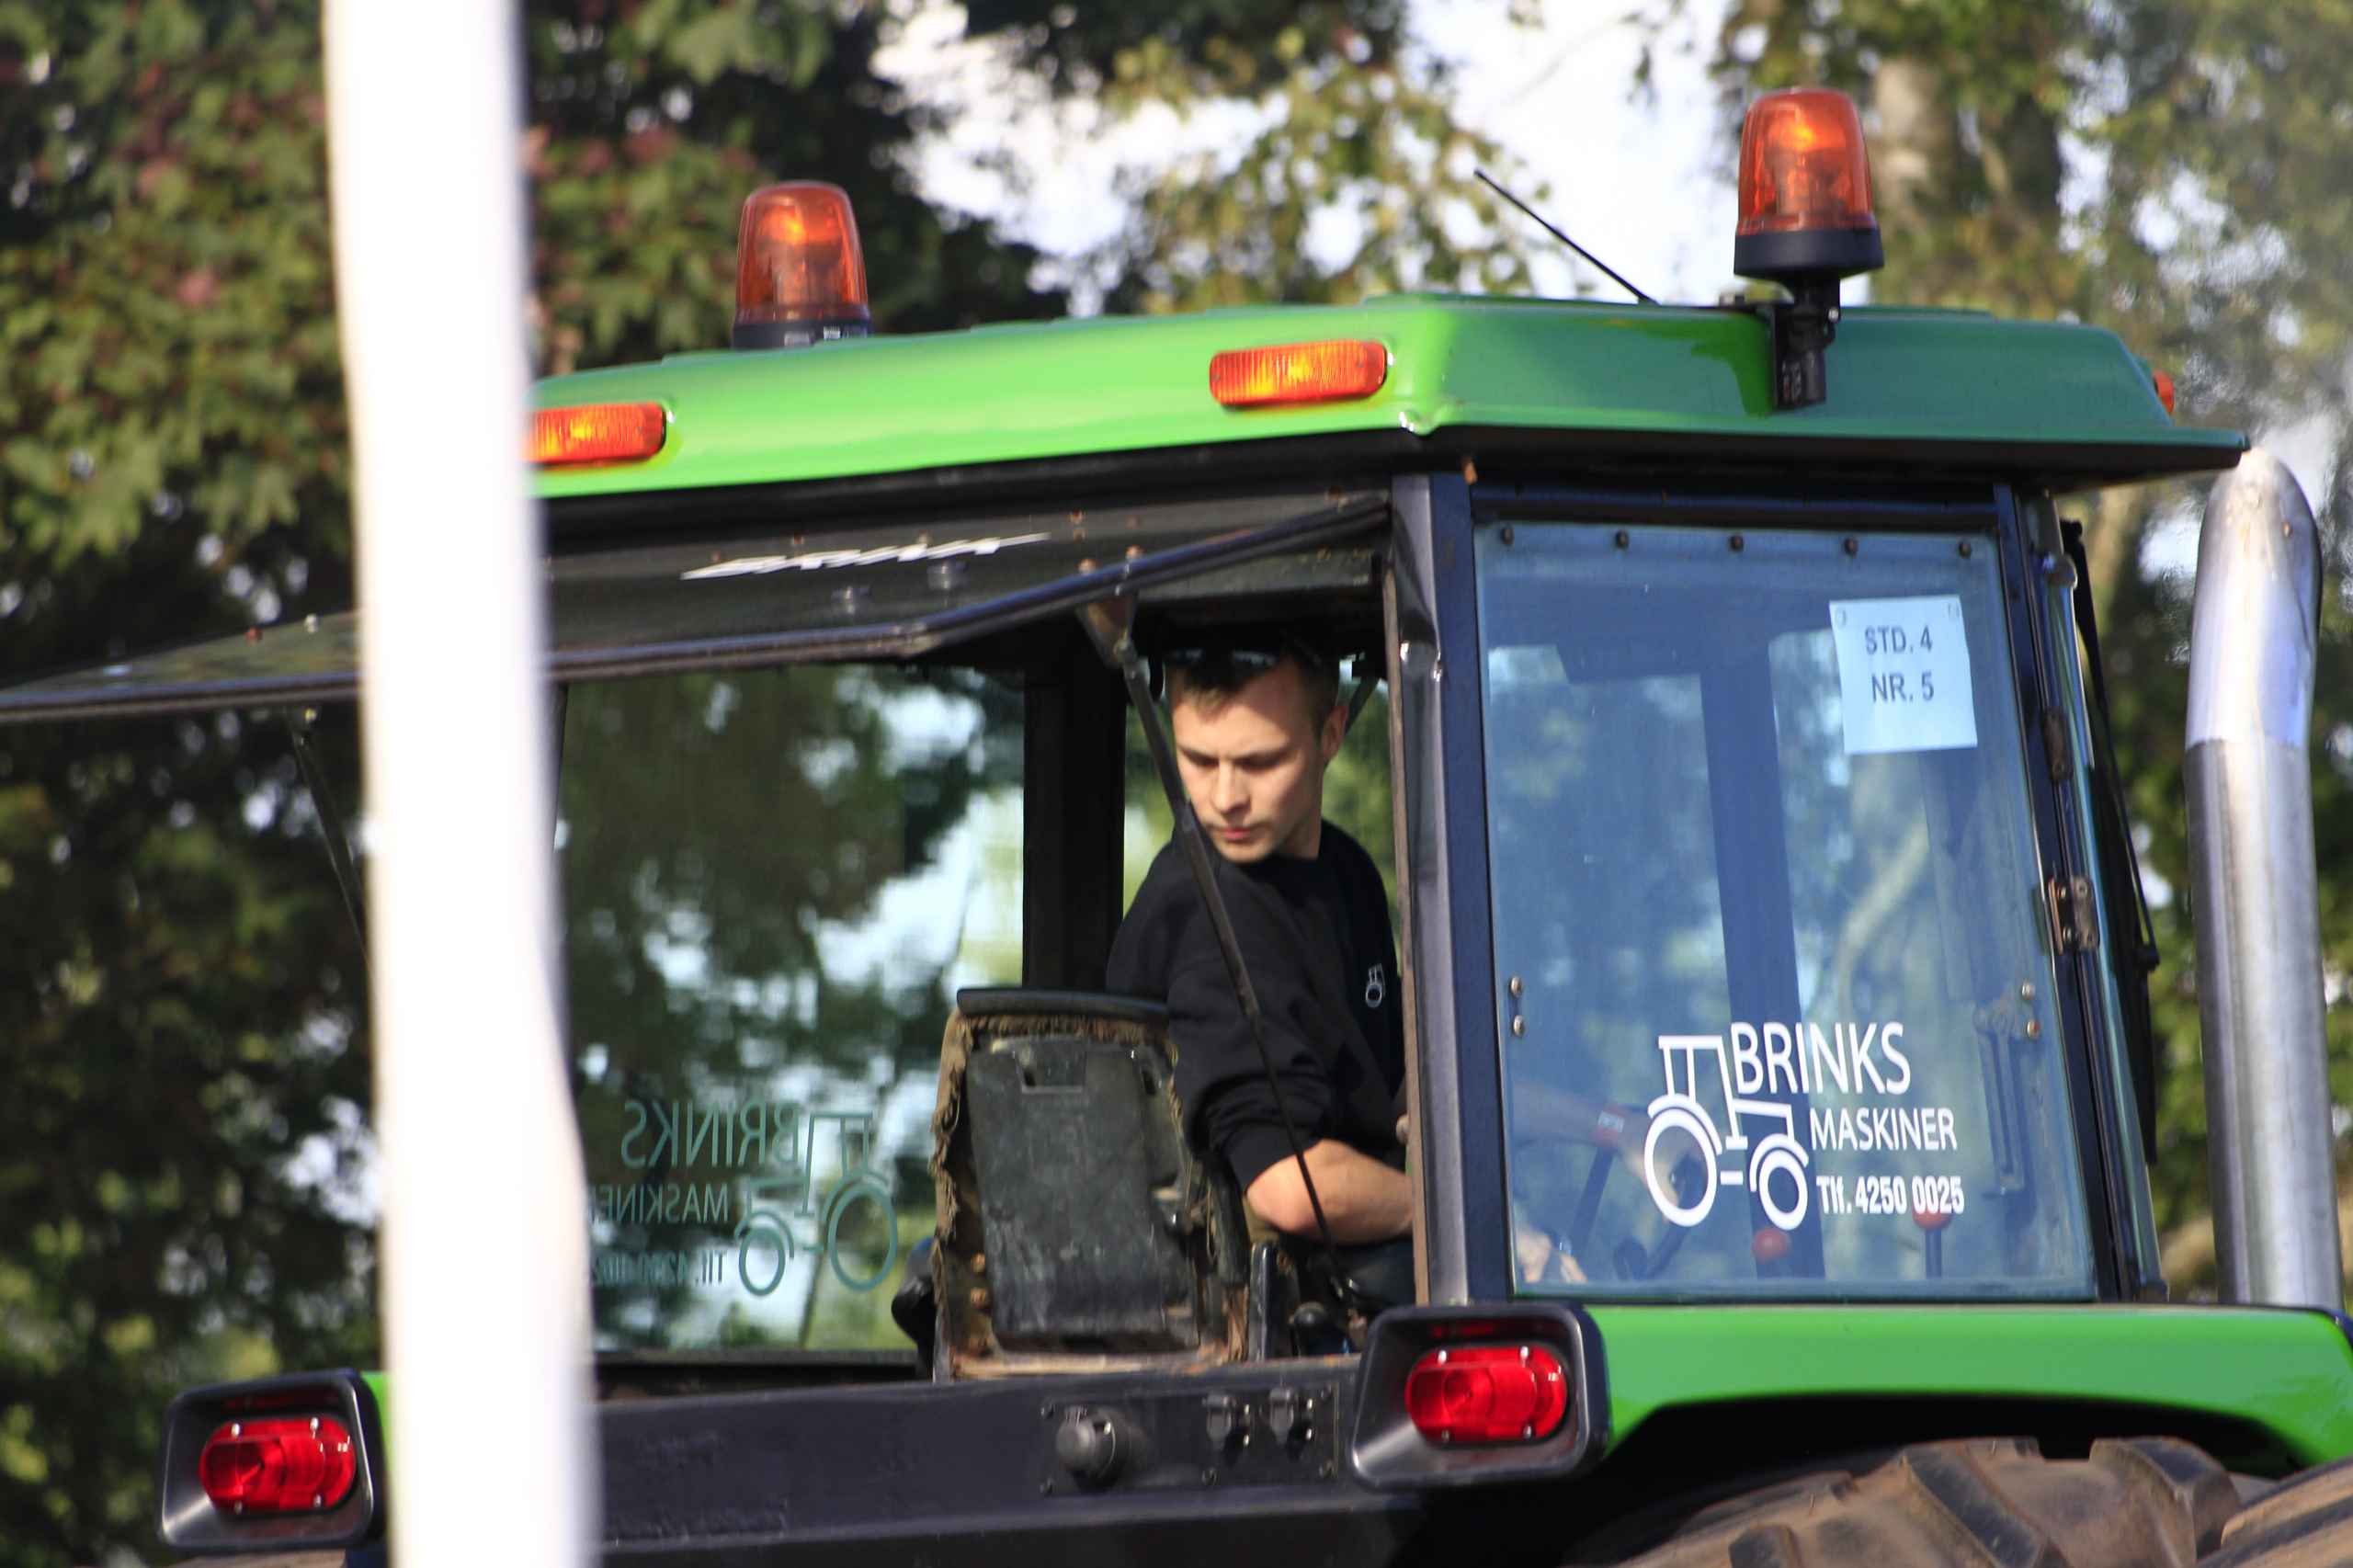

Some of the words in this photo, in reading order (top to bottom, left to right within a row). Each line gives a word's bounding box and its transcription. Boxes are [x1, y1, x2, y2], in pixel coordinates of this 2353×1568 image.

[1864, 625, 1914, 655] STD.
[1920, 624, 1934, 653] 4
[1871, 672, 1914, 703] NR.
[1921, 671, 1935, 702] 5
[1731, 1021, 1911, 1095] BRINKS
[1809, 1107, 1958, 1151] MASKINER
[1816, 1175, 1852, 1214] Tlf.
[1855, 1175, 1907, 1214] 4250
[1911, 1175, 1965, 1215] 0025
